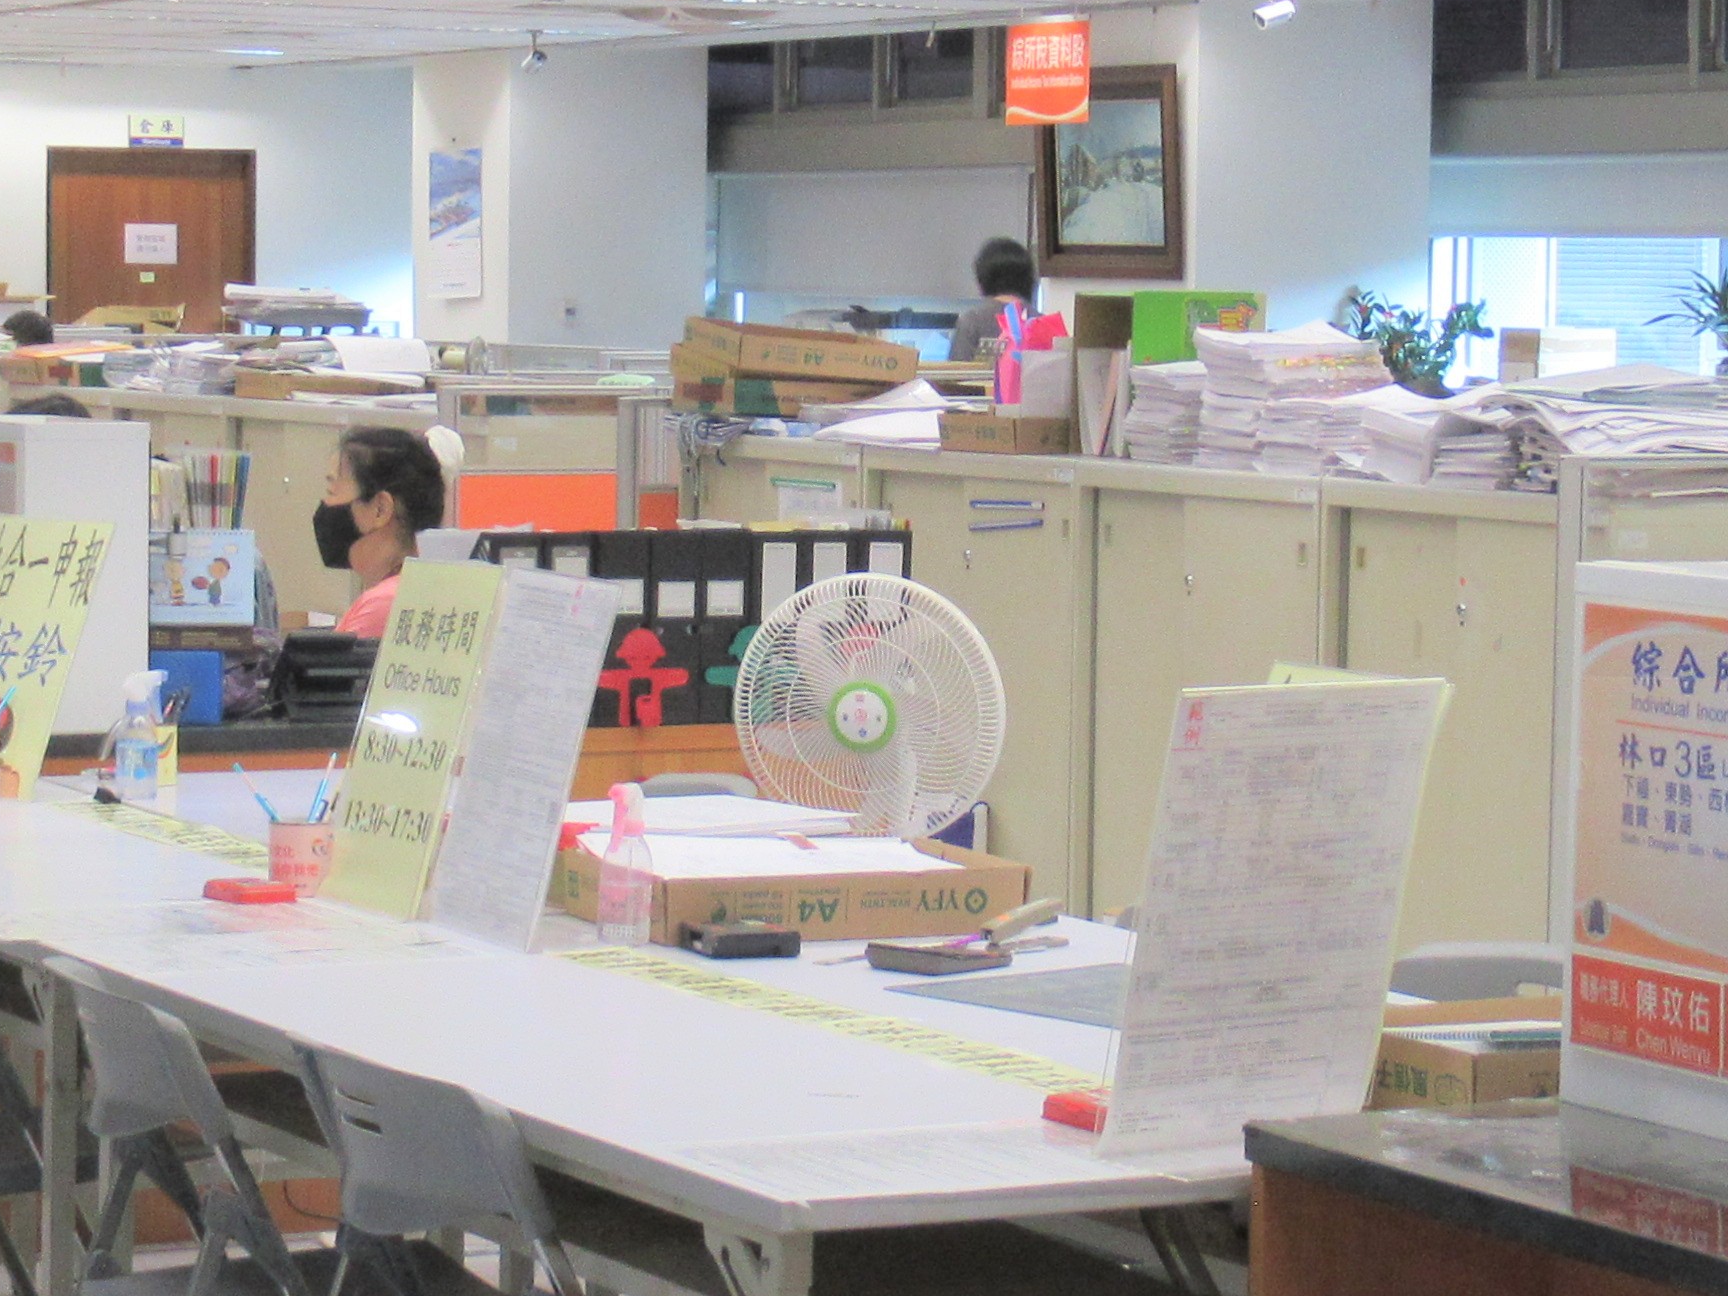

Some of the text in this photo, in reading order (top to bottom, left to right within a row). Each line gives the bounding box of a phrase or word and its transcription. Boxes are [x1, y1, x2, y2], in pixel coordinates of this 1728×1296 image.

[393, 606, 480, 655] 服務時間
[384, 663, 462, 698] Office Hours
[1631, 694, 1690, 716] Individual
[798, 898, 839, 924] A4
[917, 889, 959, 913] YFY
[1636, 1027, 1668, 1053] Chen
